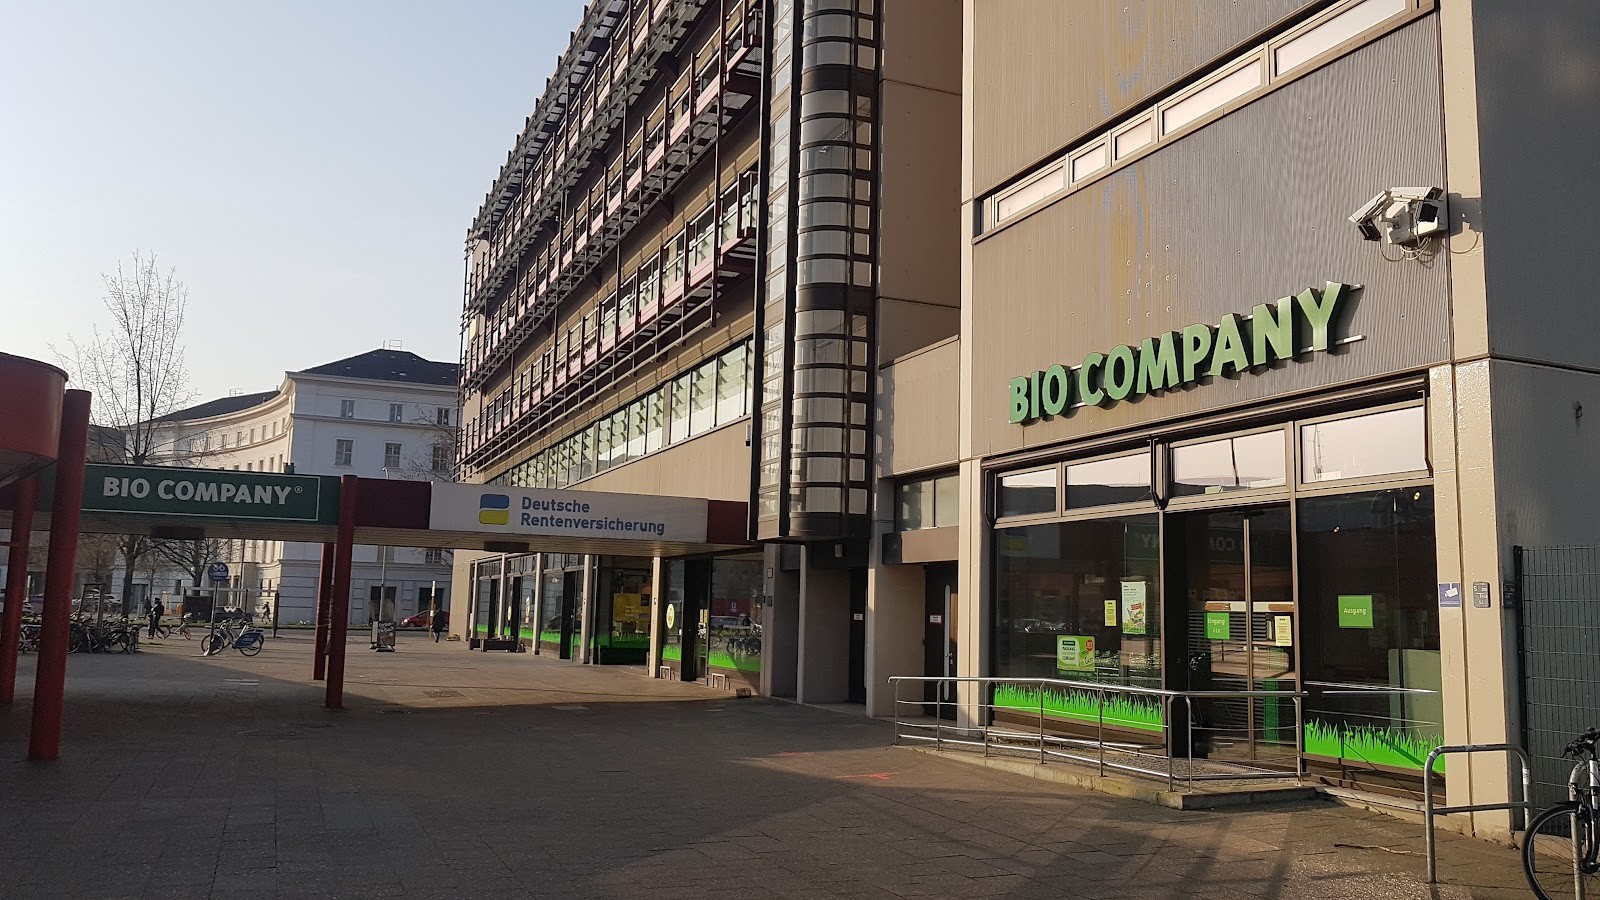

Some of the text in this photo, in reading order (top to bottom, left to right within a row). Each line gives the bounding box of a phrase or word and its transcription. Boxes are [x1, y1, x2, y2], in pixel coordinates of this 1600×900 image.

[1010, 281, 1346, 424] BIO COMPANY
[103, 476, 150, 499] BIO
[521, 496, 590, 514] Deutsche
[520, 512, 665, 536] Rentenversicherung
[1343, 607, 1367, 616] Ausgang
